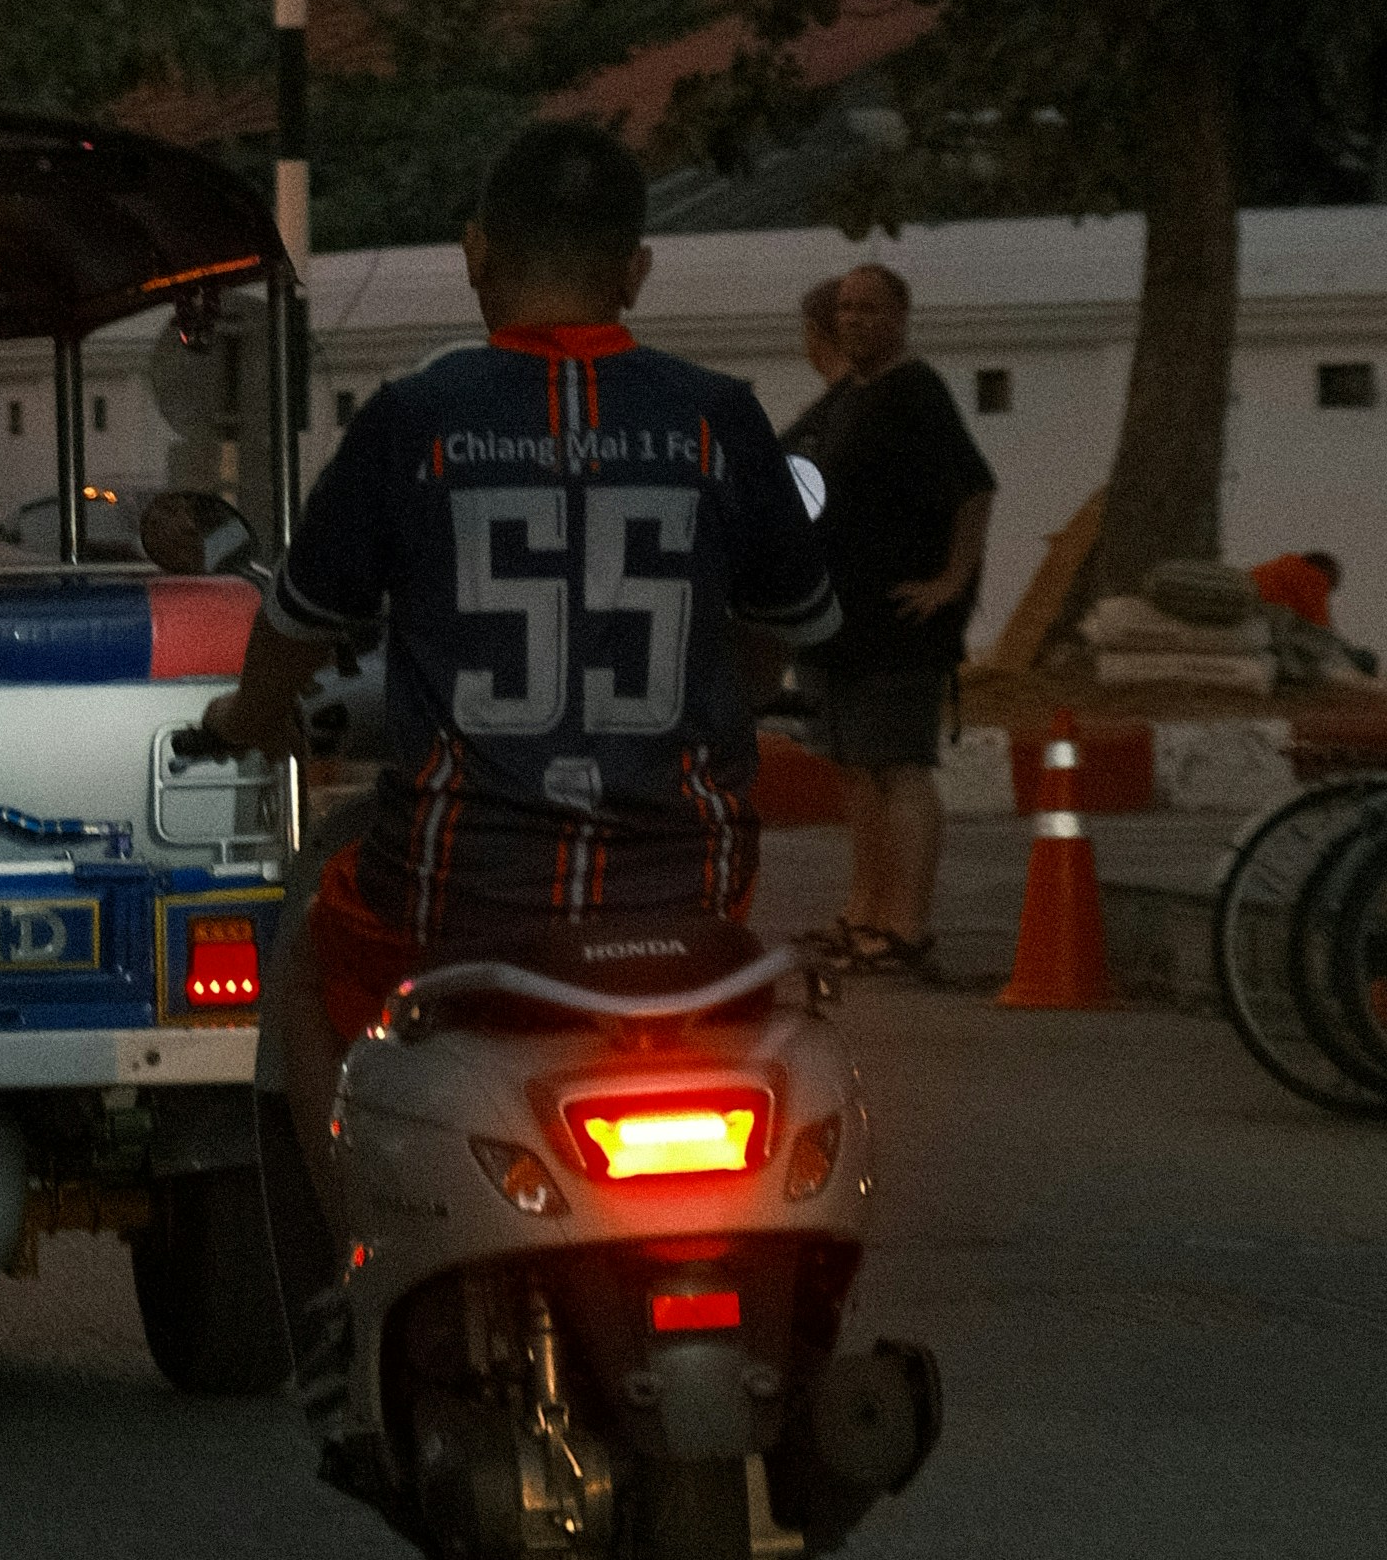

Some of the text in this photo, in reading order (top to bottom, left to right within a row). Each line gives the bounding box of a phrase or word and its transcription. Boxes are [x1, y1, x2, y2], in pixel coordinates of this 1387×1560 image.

[445, 431, 557, 469] Chiang
[564, 429, 629, 462] Mai
[638, 433, 657, 460] 1
[449, 486, 701, 735] 55
[582, 938, 690, 963] HONDA
